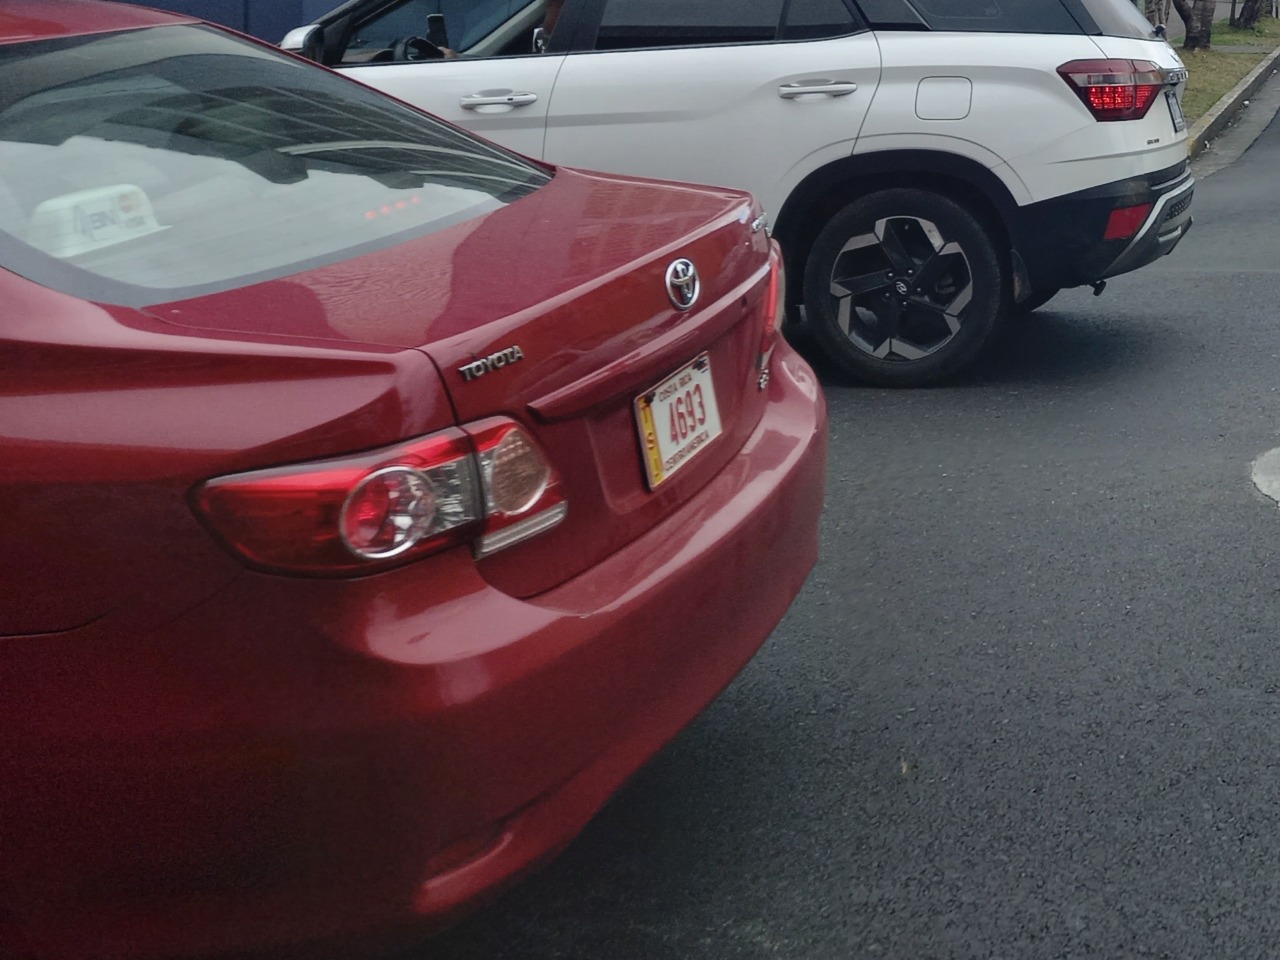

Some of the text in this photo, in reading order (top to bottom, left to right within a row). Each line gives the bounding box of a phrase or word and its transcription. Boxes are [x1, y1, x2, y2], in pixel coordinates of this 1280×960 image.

[457, 344, 524, 381] TOYOTA
[658, 381, 678, 403] COSTA
[668, 383, 706, 446] 4693
